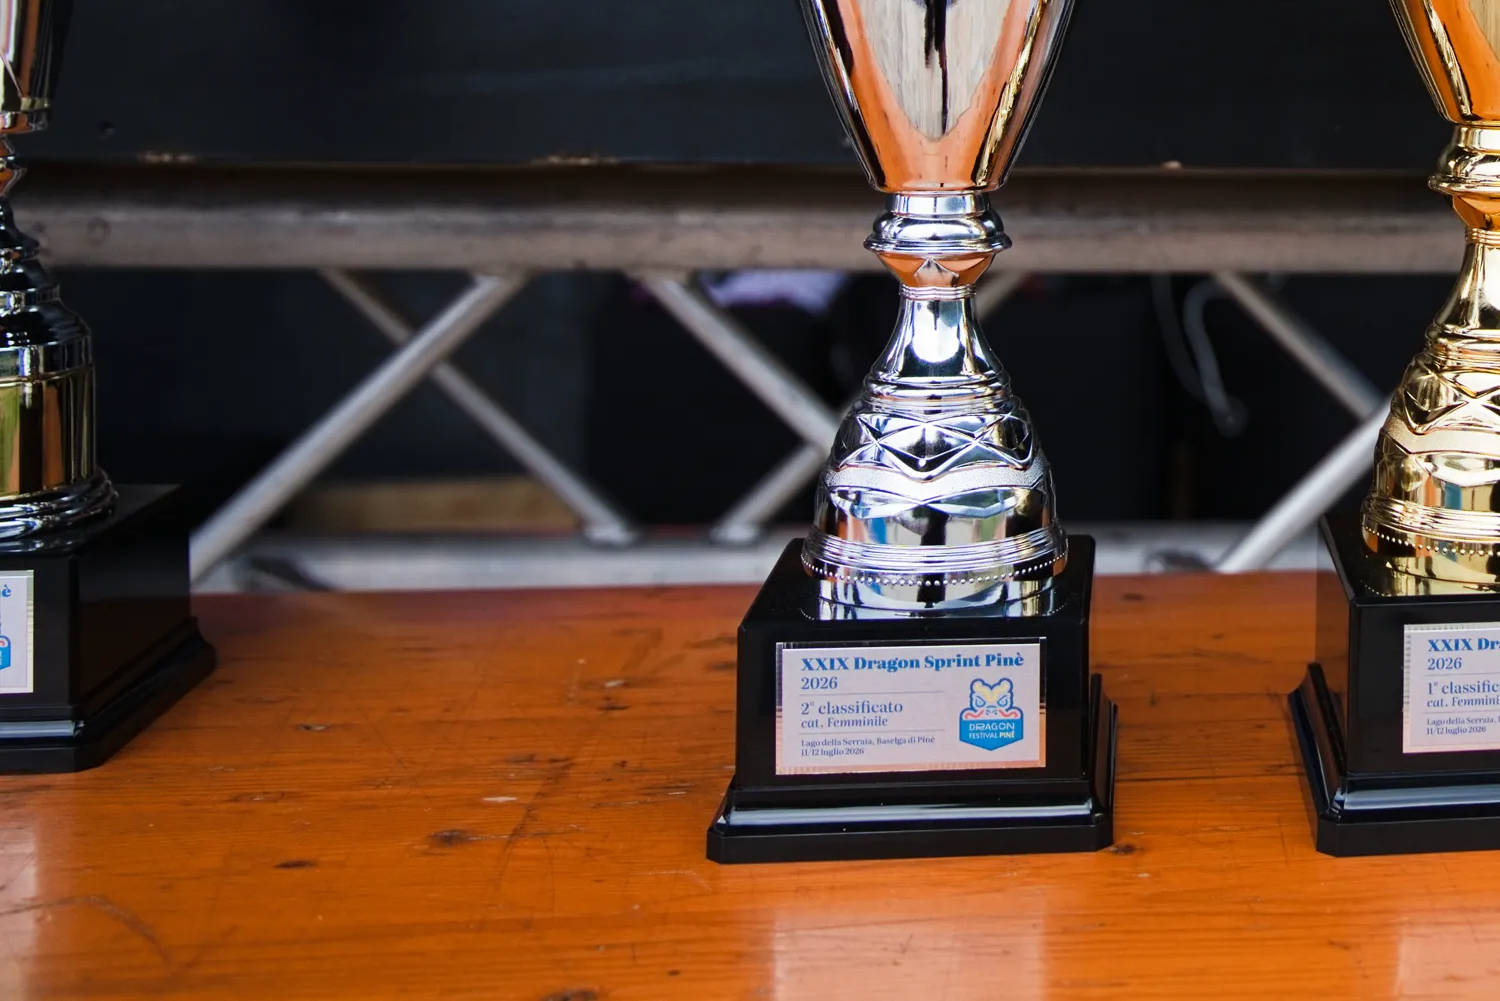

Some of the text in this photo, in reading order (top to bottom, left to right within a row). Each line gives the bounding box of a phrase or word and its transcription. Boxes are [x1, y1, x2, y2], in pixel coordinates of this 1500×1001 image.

[1428, 638, 1473, 652] XXIX
[801, 652, 1024, 673] XXIX Dragon Sprint Pinè
[1428, 657, 1462, 670] 2026
[801, 676, 838, 690] 2026
[818, 700, 903, 715] classificato
[1427, 698, 1448, 707] cat.
[801, 715, 888, 729] cat. Femminile
[969, 722, 1015, 731] DRAGON
[1427, 718, 1445, 726] Lago
[1445, 727, 1467, 735] luglio
[801, 739, 820, 748] Lago
[821, 738, 841, 746] della
[842, 737, 875, 746] Serraia,
[876, 736, 906, 746] Baselga
[907, 736, 916, 744] di
[820, 748, 844, 757] luglio
[845, 747, 865, 755] 2026
